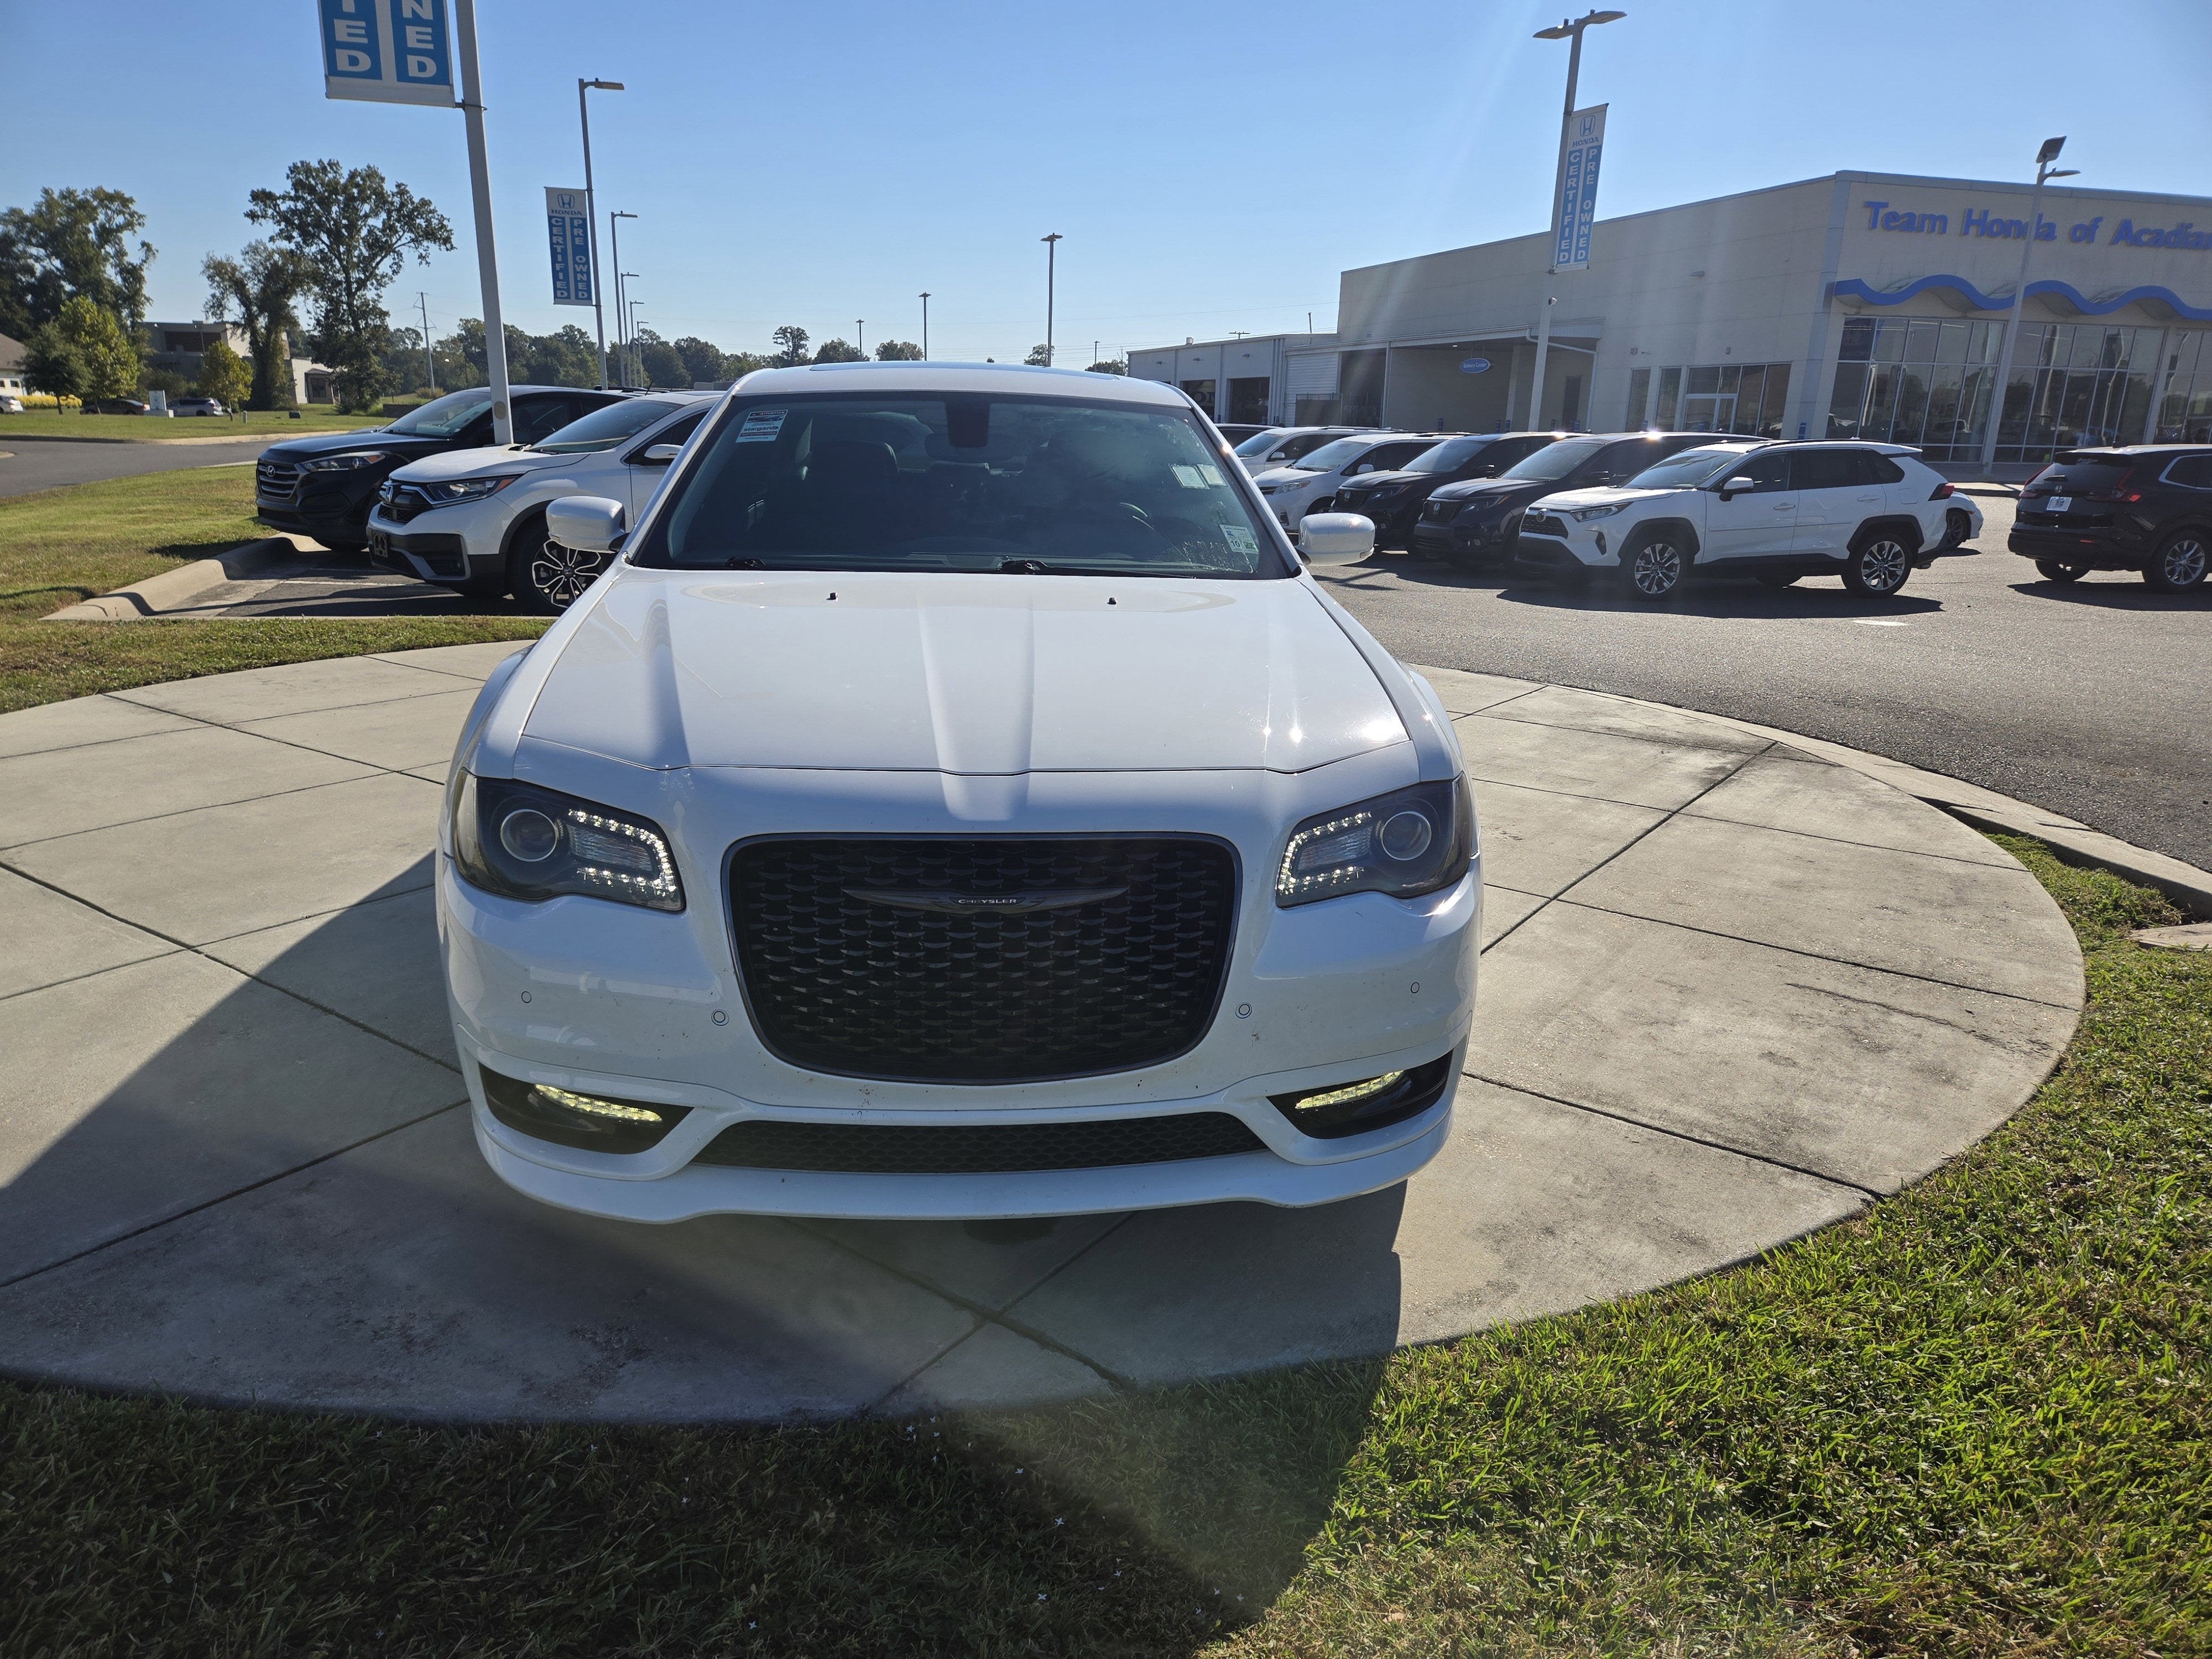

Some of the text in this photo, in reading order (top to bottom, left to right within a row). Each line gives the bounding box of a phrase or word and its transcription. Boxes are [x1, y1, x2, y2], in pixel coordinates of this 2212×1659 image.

[1572, 137, 1599, 148] HONDA
[1559, 152, 1581, 262] CERTIFIED
[1577, 149, 1597, 260] PRE OWNED
[1865, 201, 1948, 234] Team
[1963, 208, 2057, 242] Honda
[2070, 216, 2103, 244] of
[551, 218, 568, 298] CERTIFIED
[573, 220, 588, 299] PRE OWNED
